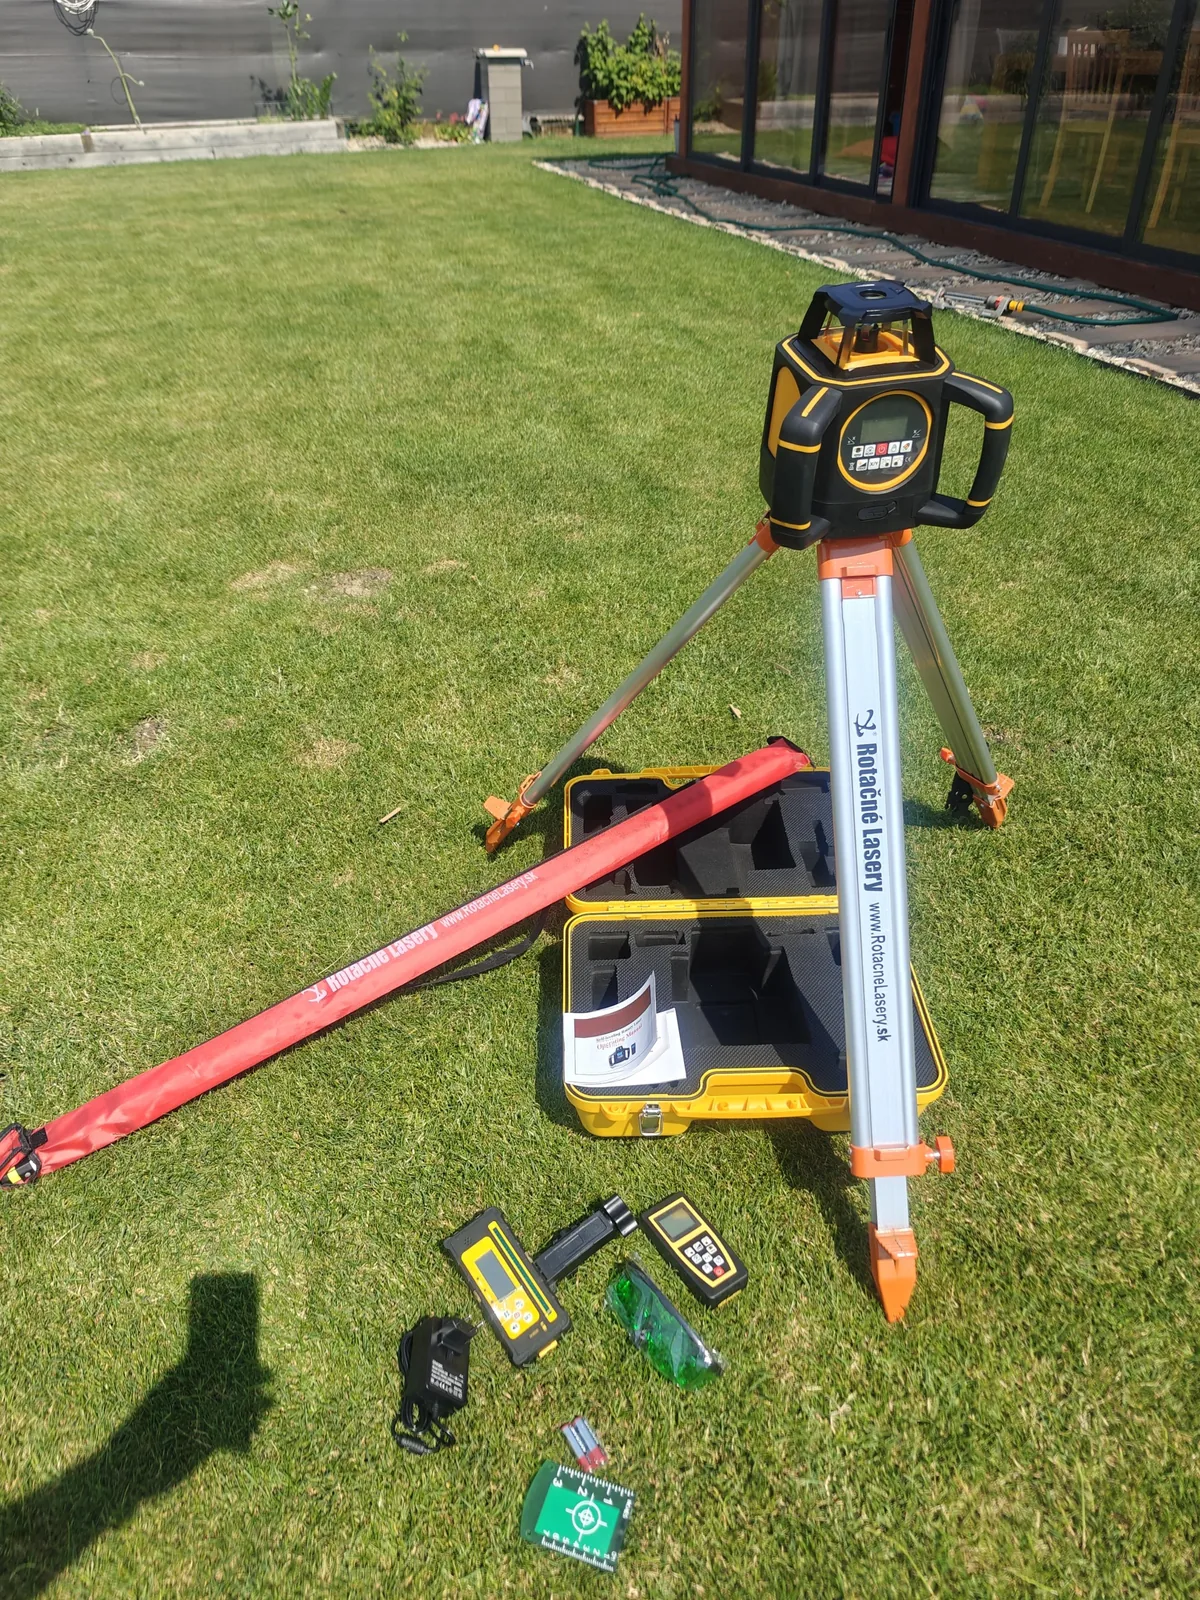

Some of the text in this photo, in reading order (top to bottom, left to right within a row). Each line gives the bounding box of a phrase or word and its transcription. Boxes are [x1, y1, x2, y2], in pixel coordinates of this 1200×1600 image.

[856, 743, 892, 1042] Rotačné Lasery www.RotacneLasery.sk
[386, 923, 438, 959] Lasery
[596, 1036, 626, 1051] Operating
[552, 1477, 563, 1488] 3
[577, 1485, 588, 1497] 2
